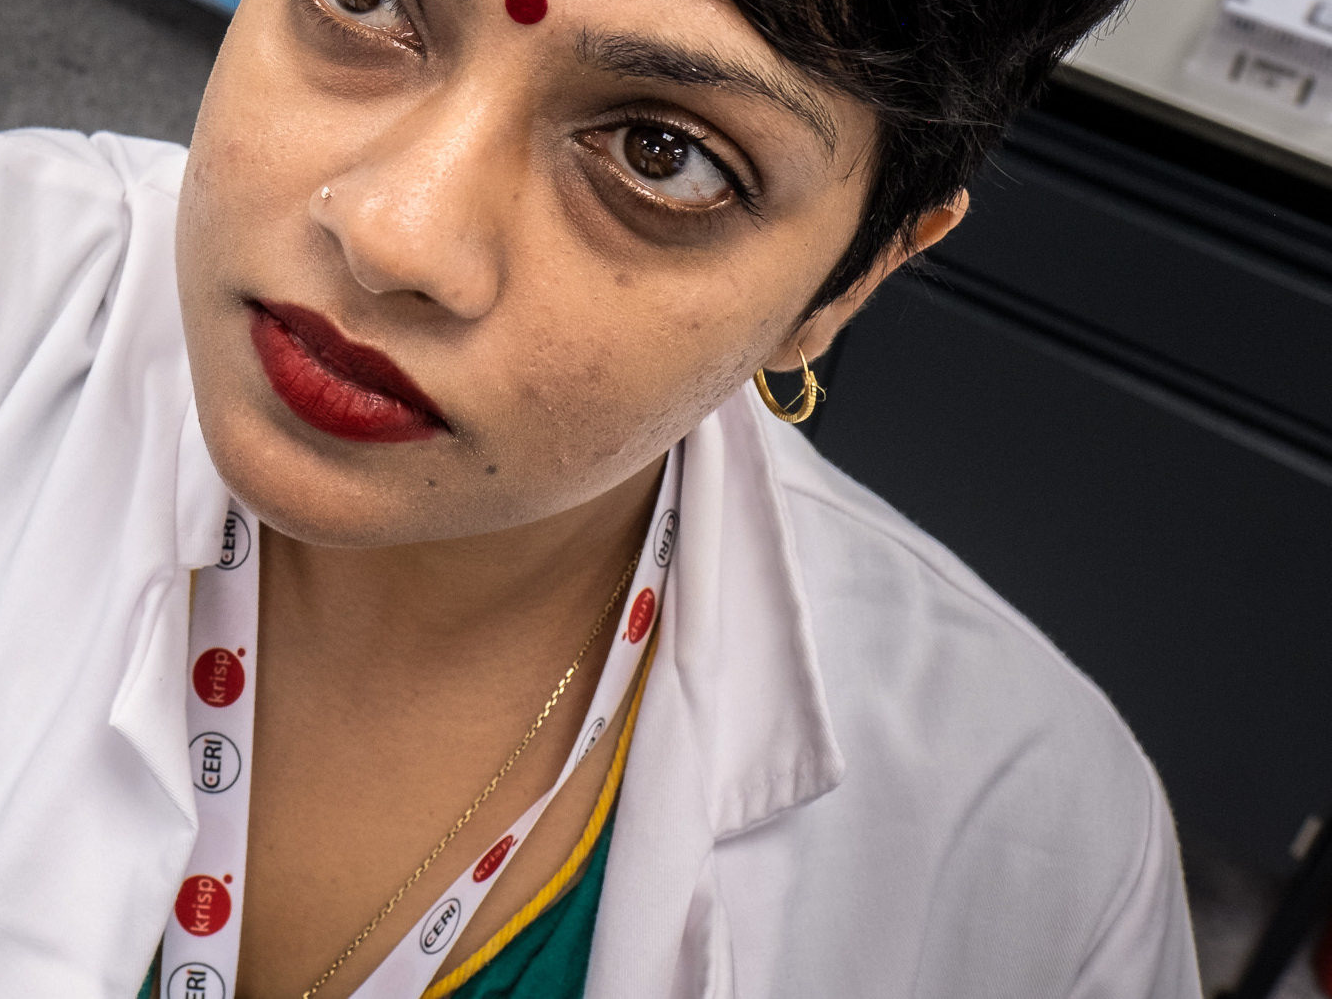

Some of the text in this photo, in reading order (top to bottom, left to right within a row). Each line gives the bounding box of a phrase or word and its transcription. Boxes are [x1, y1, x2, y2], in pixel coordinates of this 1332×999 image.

[220, 518, 236, 566] CERI
[658, 513, 676, 562] CERI
[630, 591, 653, 640] krisp
[207, 651, 233, 704] krisp
[201, 737, 223, 789] CERI
[189, 877, 217, 933] krisp
[424, 903, 457, 949] CERI
[185, 968, 207, 999] ERI
